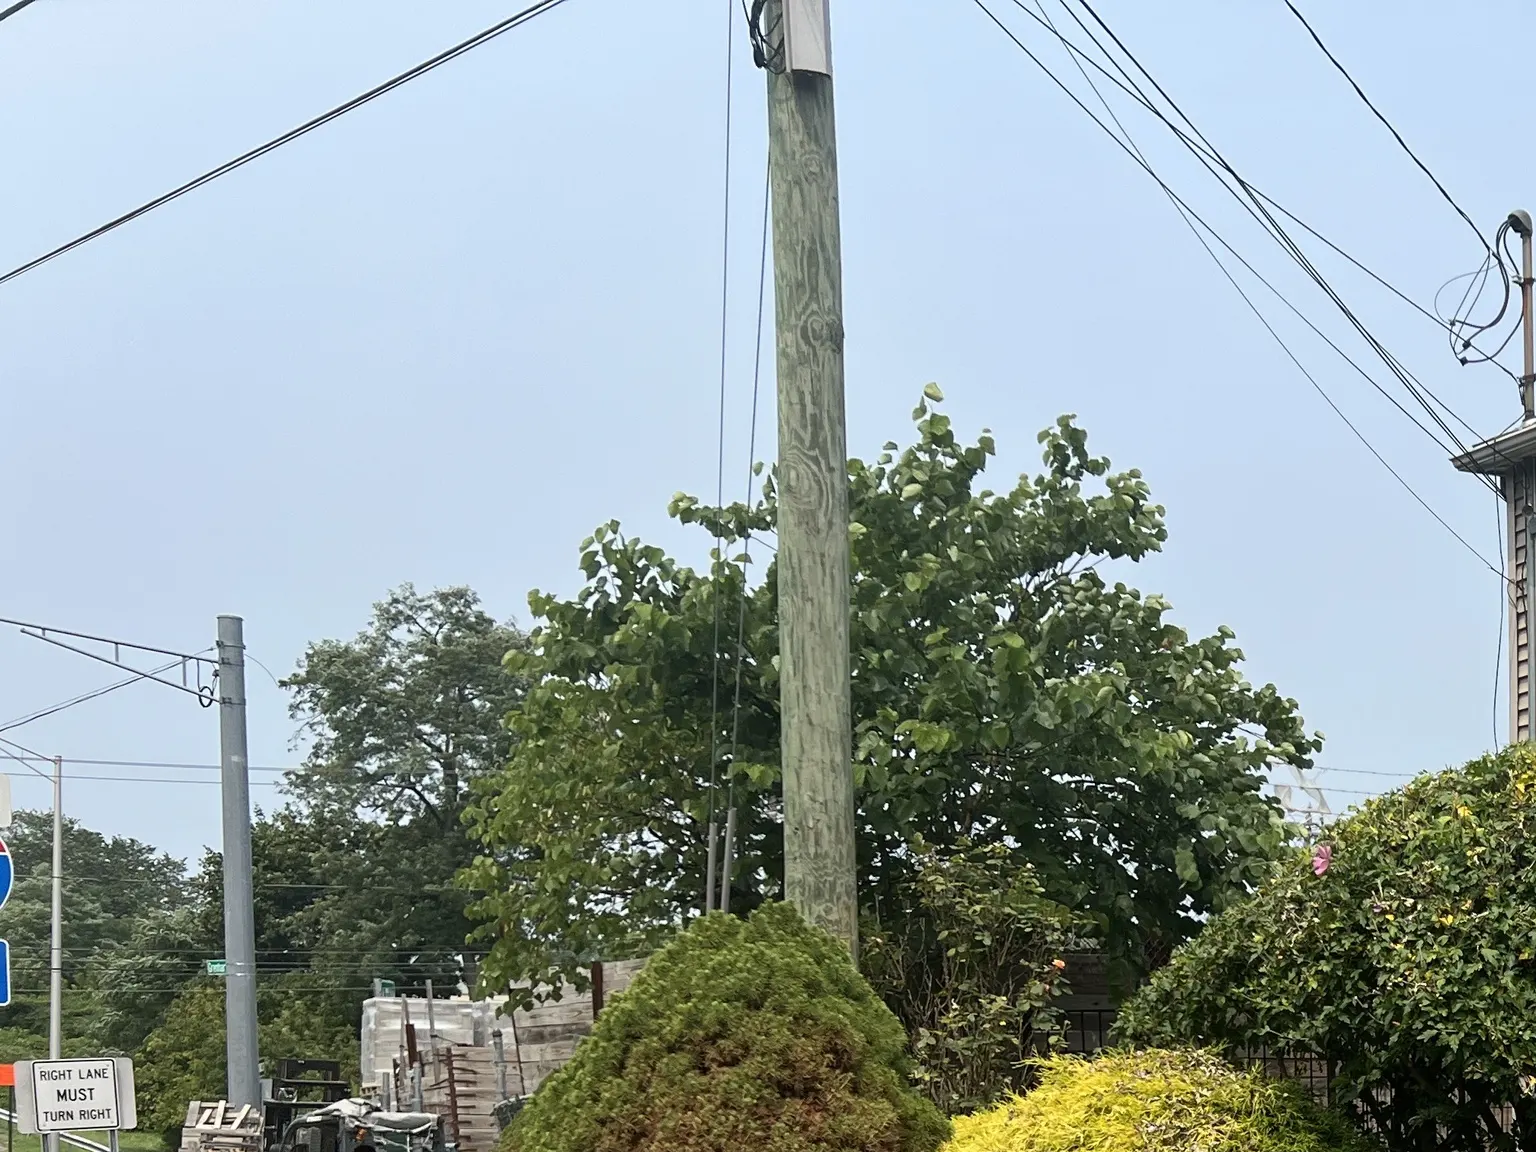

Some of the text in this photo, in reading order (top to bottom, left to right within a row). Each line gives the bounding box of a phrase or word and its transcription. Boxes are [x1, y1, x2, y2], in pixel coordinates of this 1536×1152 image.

[39, 1068, 109, 1081] RIGHT LANE
[56, 1088, 95, 1102] MUST
[43, 1108, 112, 1122] TURN RIGHT
